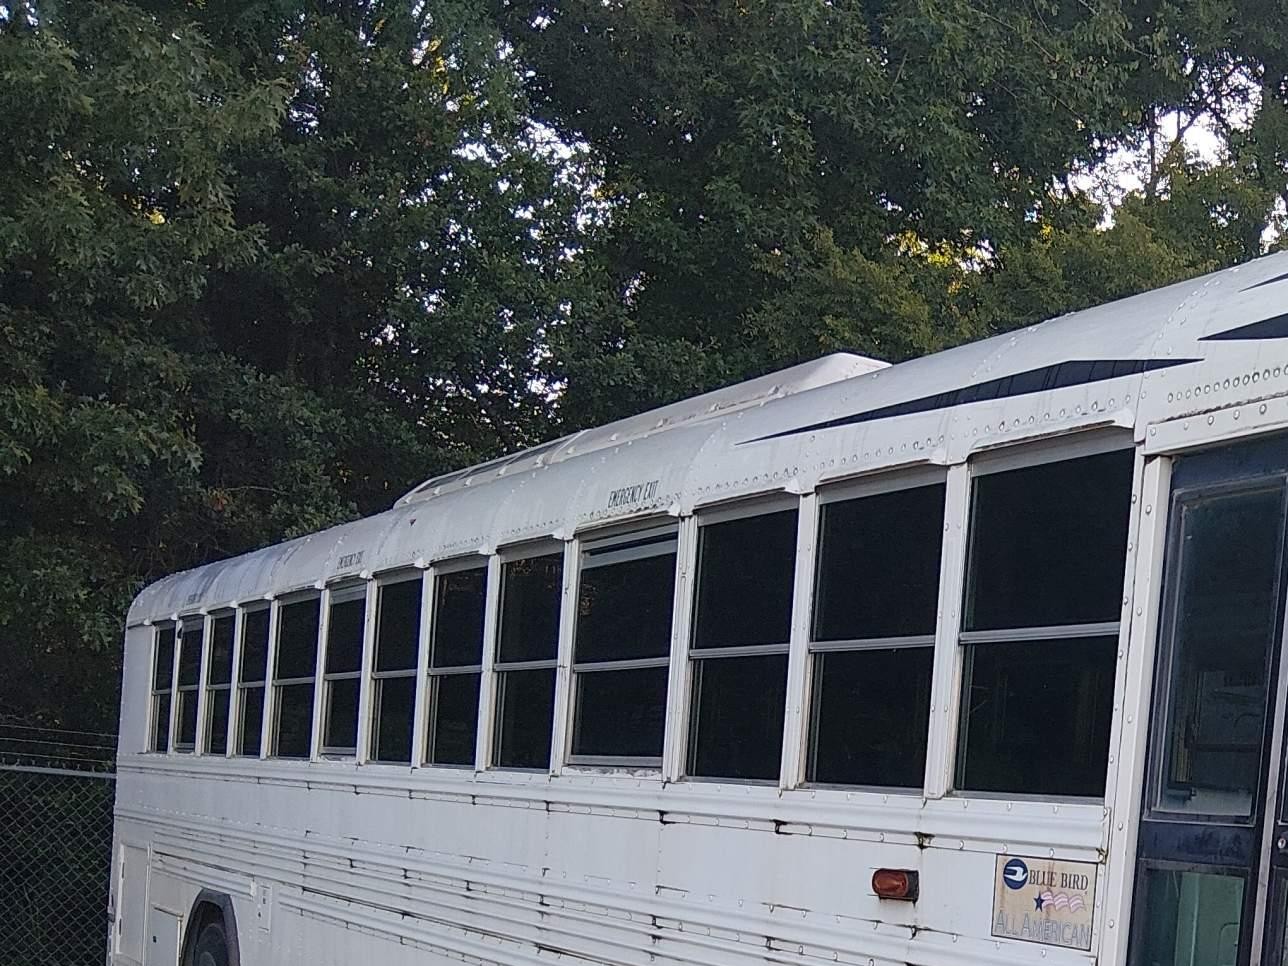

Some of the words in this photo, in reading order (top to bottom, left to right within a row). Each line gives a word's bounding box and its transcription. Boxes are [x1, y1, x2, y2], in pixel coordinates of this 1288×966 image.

[607, 483, 644, 508] EMERGENCY
[643, 480, 659, 500] EXIT
[1029, 869, 1057, 888] BLUE
[1060, 872, 1089, 891] BIRD
[994, 909, 1020, 937] ALL
[1020, 912, 1090, 948] AMERICAN
